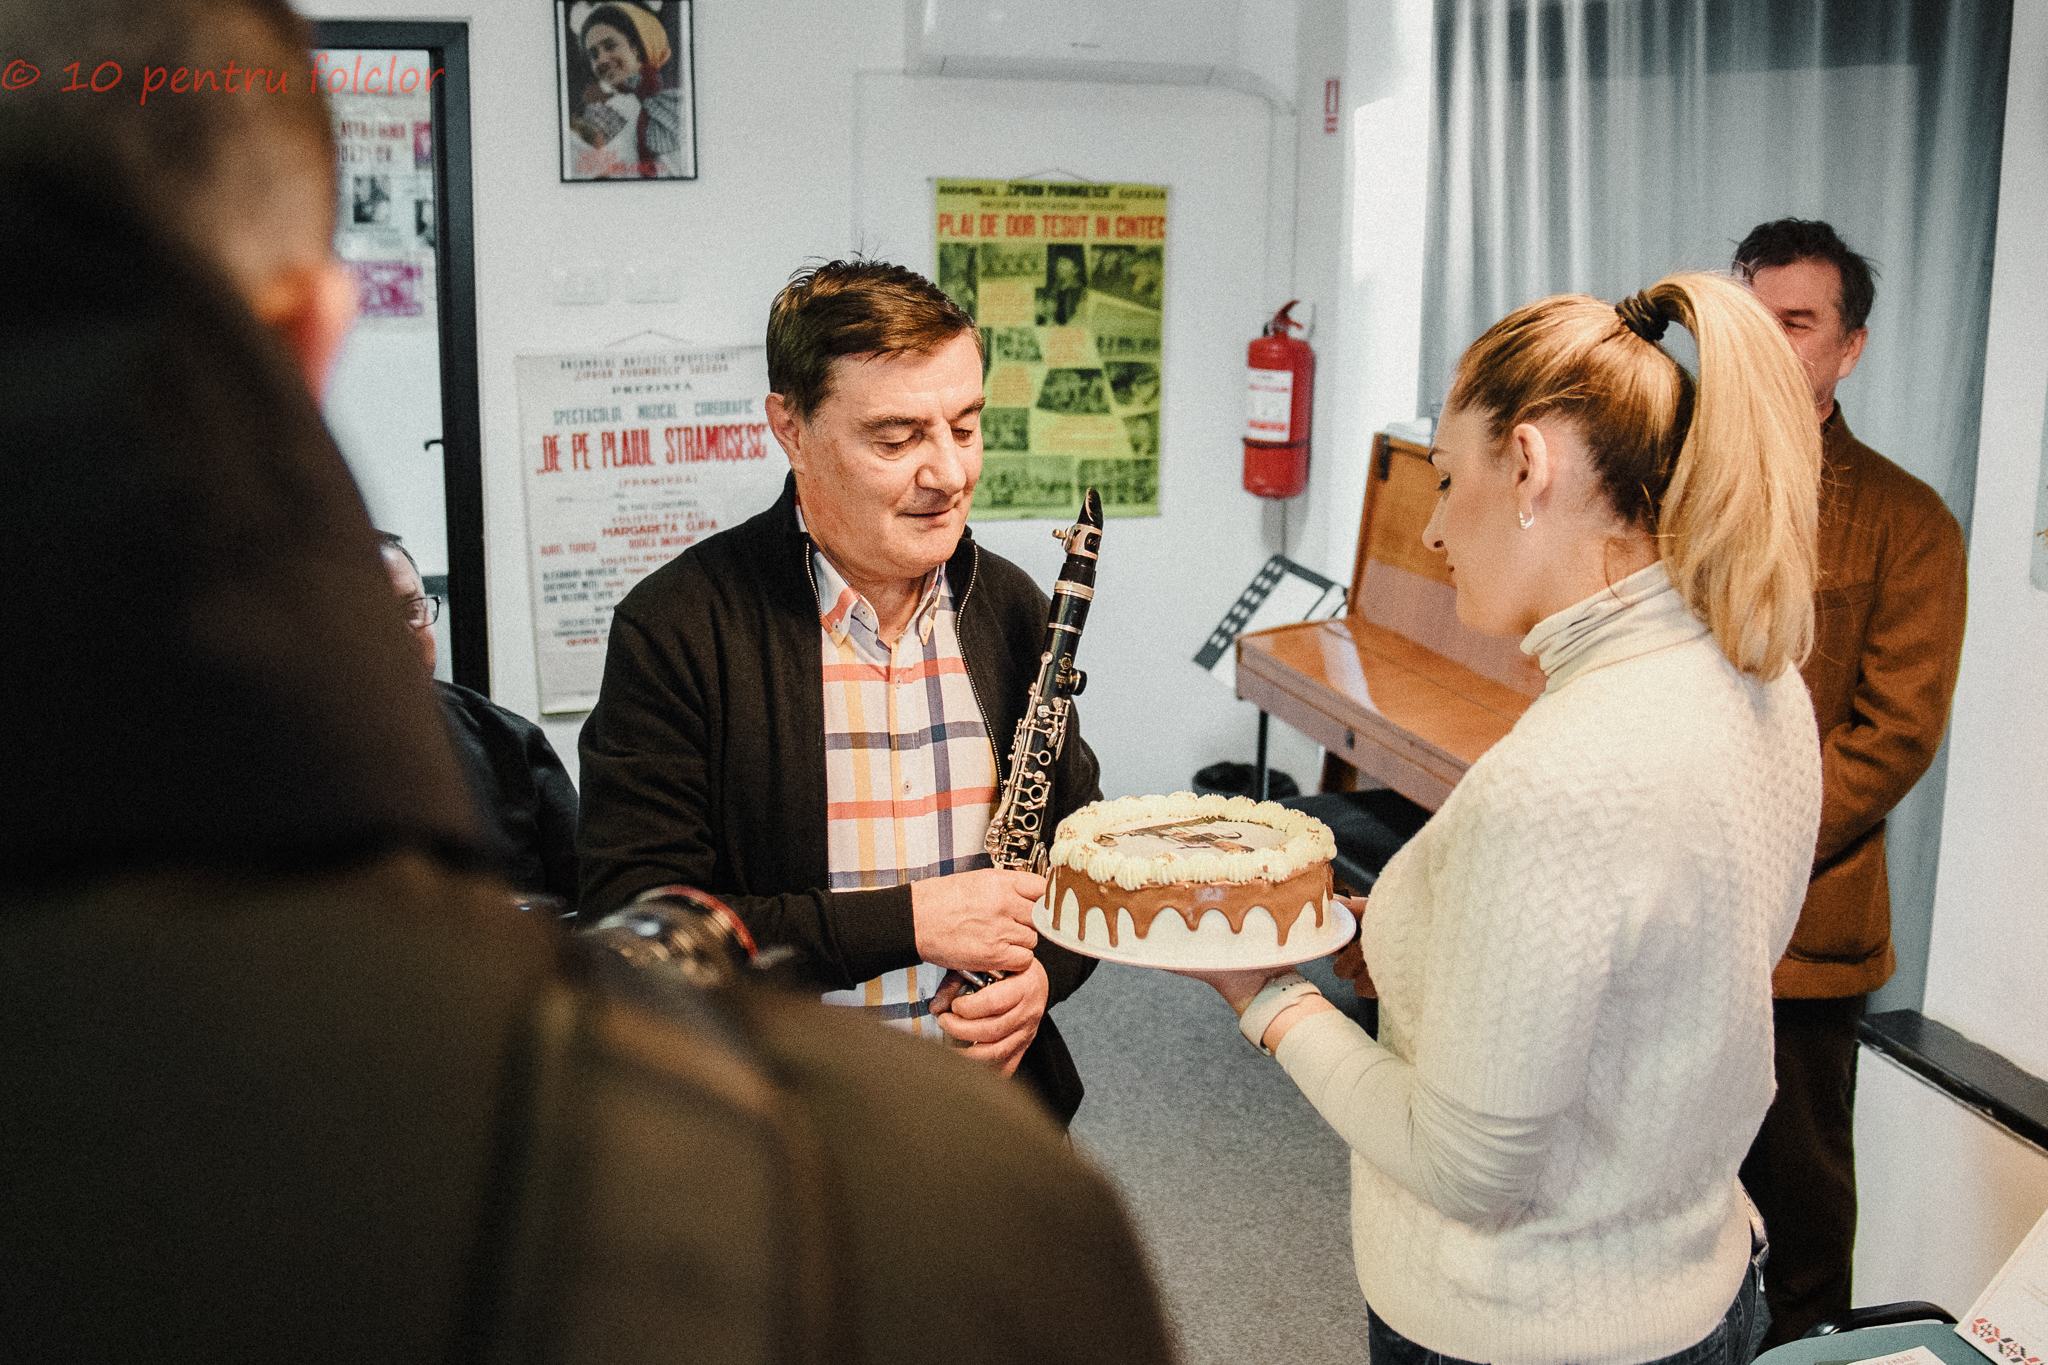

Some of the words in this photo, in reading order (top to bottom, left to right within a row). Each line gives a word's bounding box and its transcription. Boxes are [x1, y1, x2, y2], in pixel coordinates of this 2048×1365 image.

[938, 213, 975, 236] PLAI
[980, 213, 1000, 237] DE
[638, 403, 678, 420] MUZICAL
[694, 399, 754, 417] COREGRAFIC
[572, 432, 591, 470] PE
[601, 428, 655, 469] PLAIUL
[602, 523, 678, 537] MARGARETA
